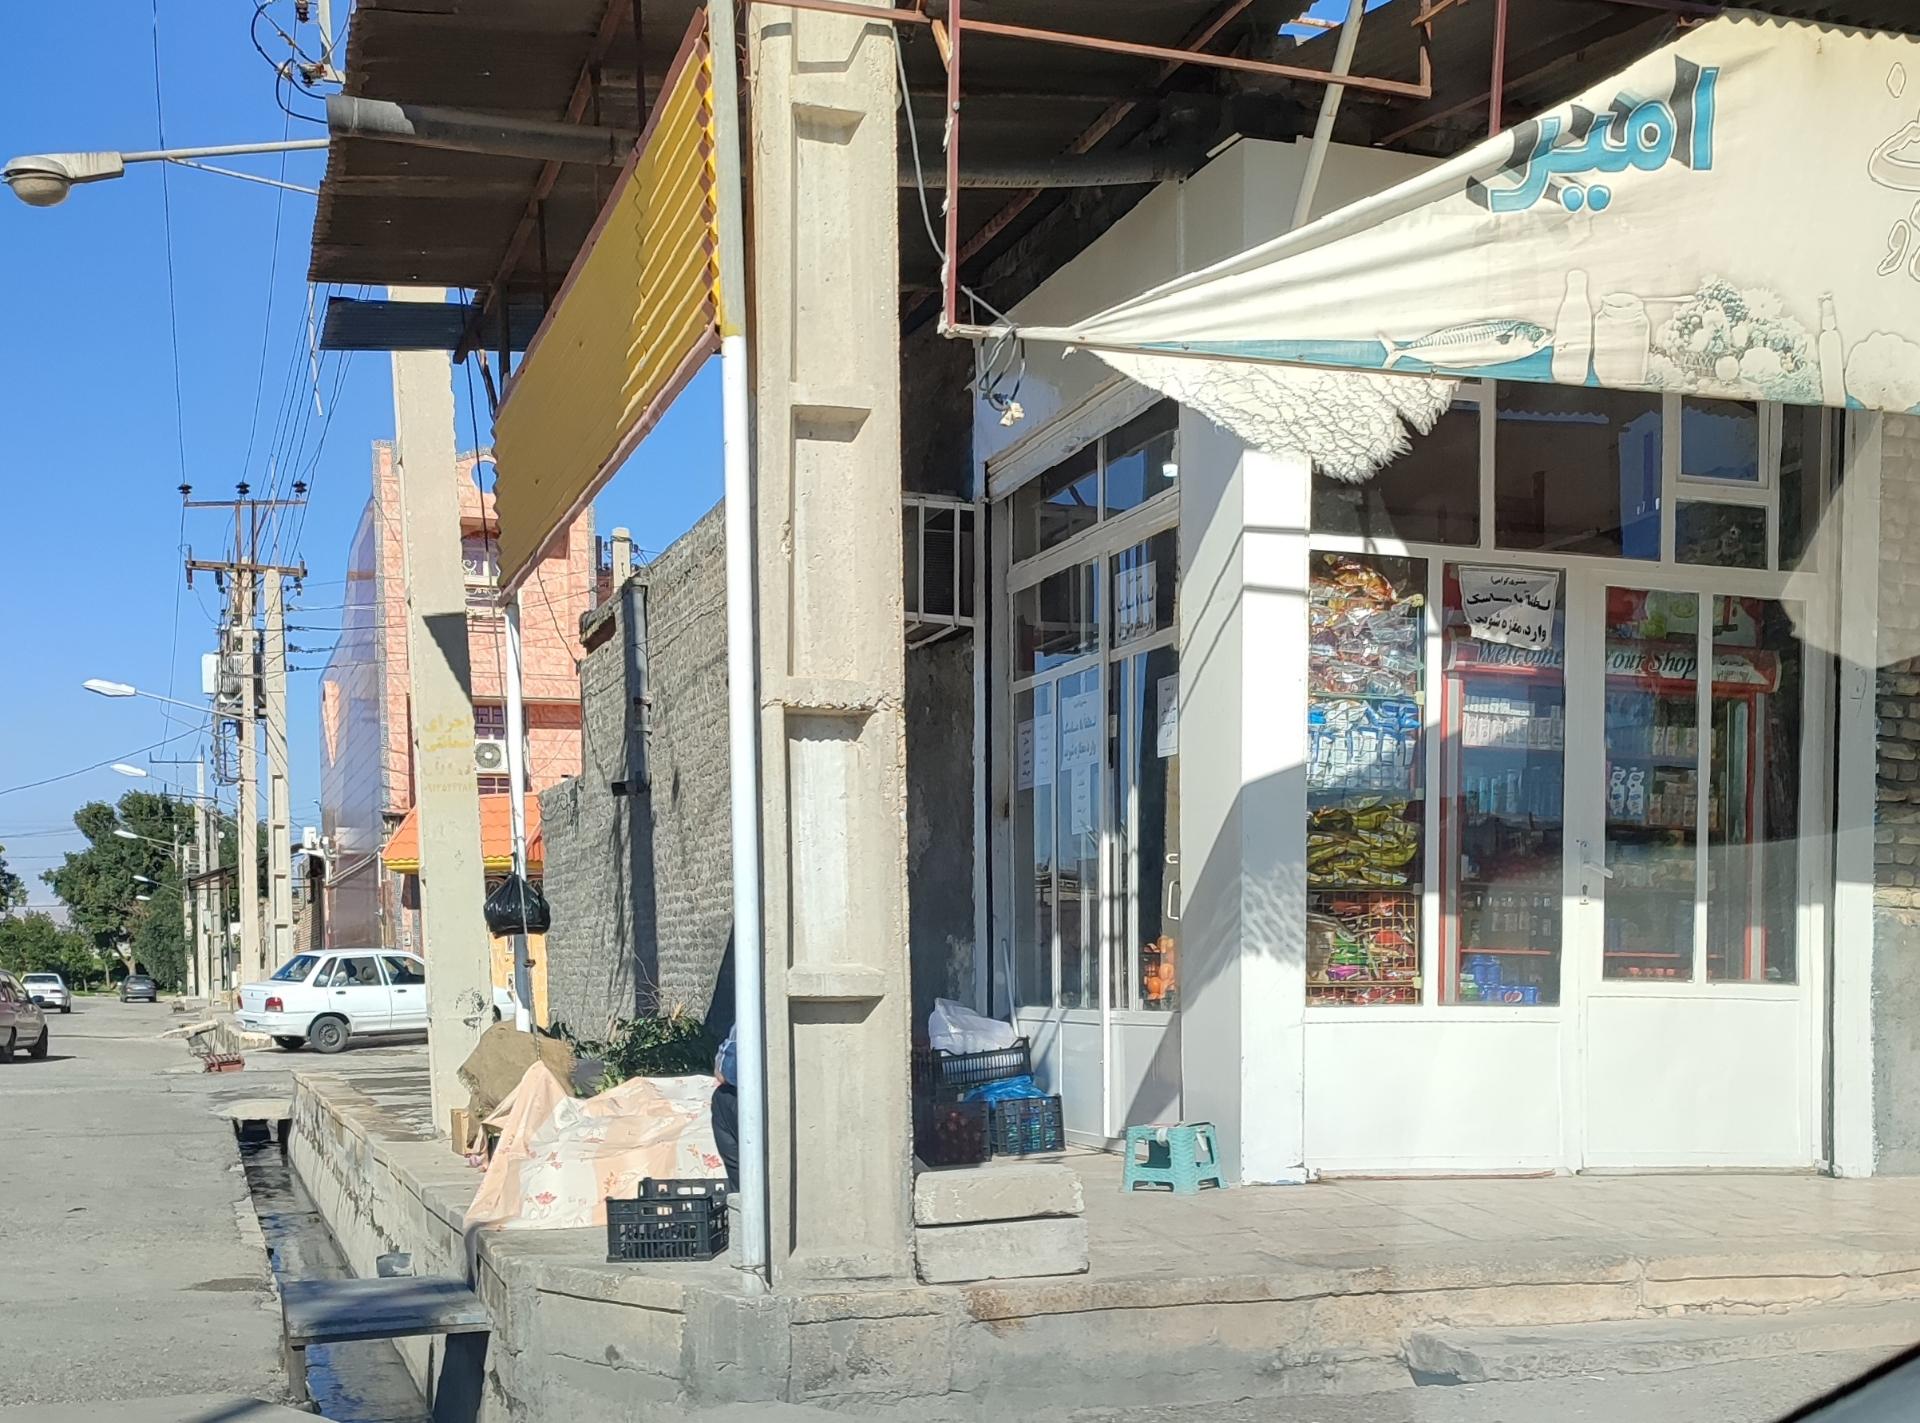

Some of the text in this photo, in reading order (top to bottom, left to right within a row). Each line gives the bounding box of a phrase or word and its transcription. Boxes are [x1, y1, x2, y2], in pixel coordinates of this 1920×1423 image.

[1481, 62, 1720, 213] امیر
[1466, 591, 1513, 605] ماسک
[1513, 591, 1524, 608] با
[1474, 611, 1501, 630] شوید
[1524, 623, 1547, 642] وارد
